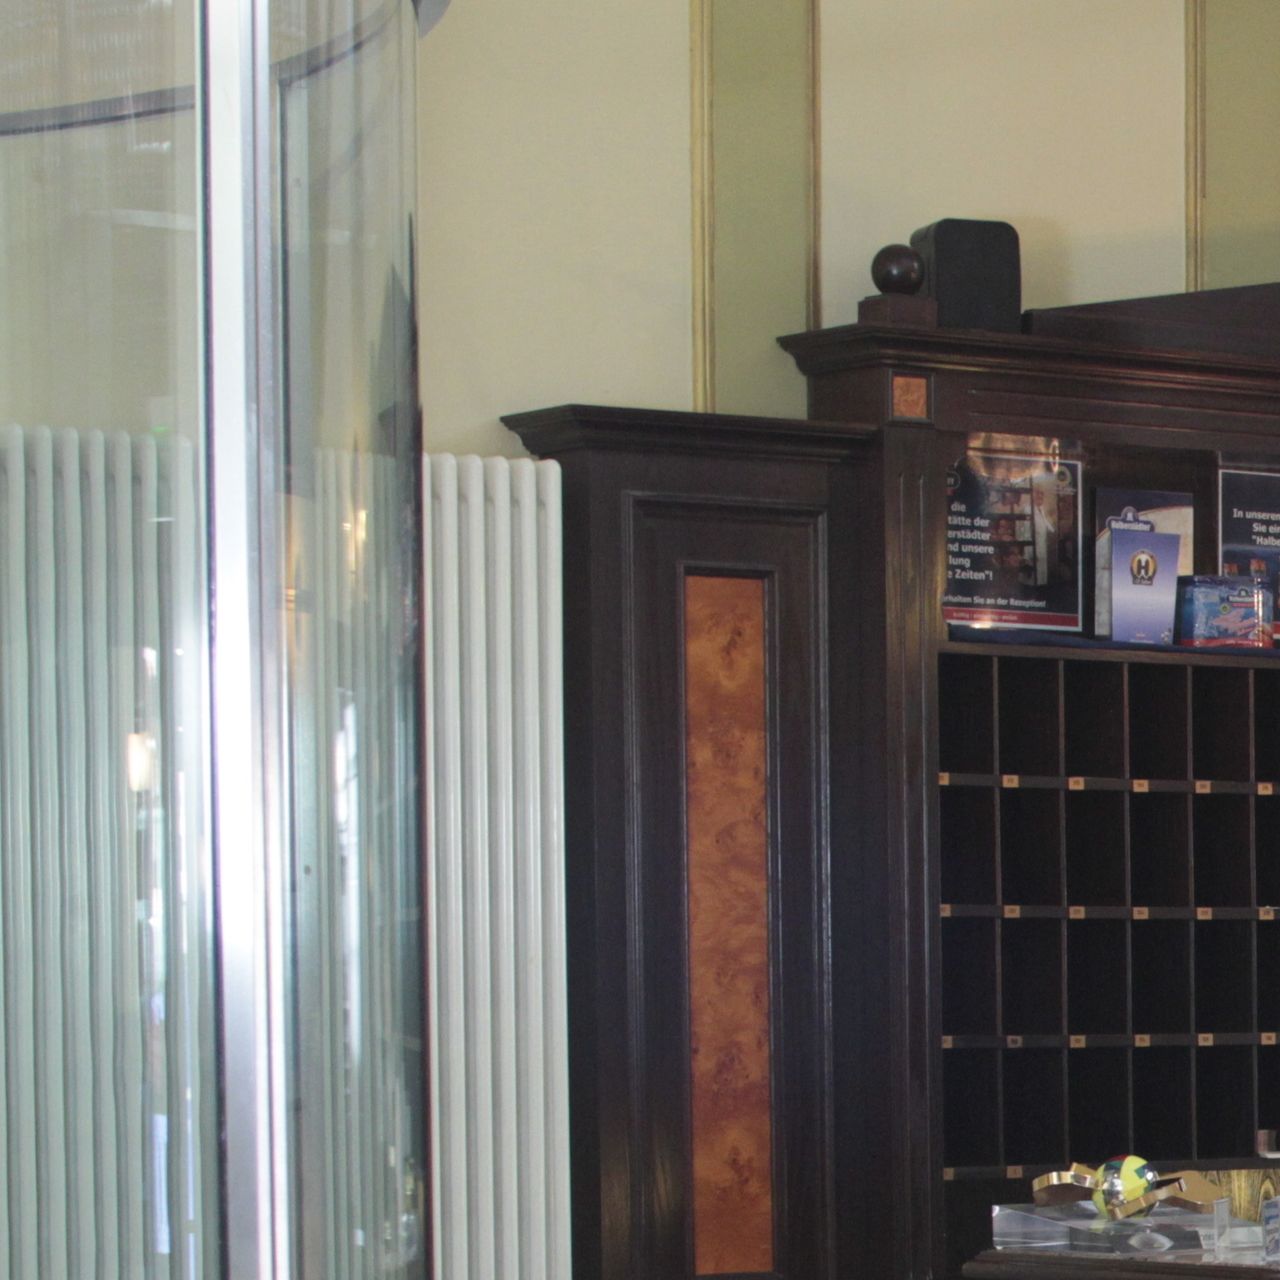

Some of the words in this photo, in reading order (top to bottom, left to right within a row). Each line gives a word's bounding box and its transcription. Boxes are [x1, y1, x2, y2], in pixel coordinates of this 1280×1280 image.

[951, 502, 966, 512] die
[1233, 508, 1243, 518] In
[974, 517, 990, 527] der
[1252, 523, 1267, 533] Sie
[961, 544, 995, 554] unsere
